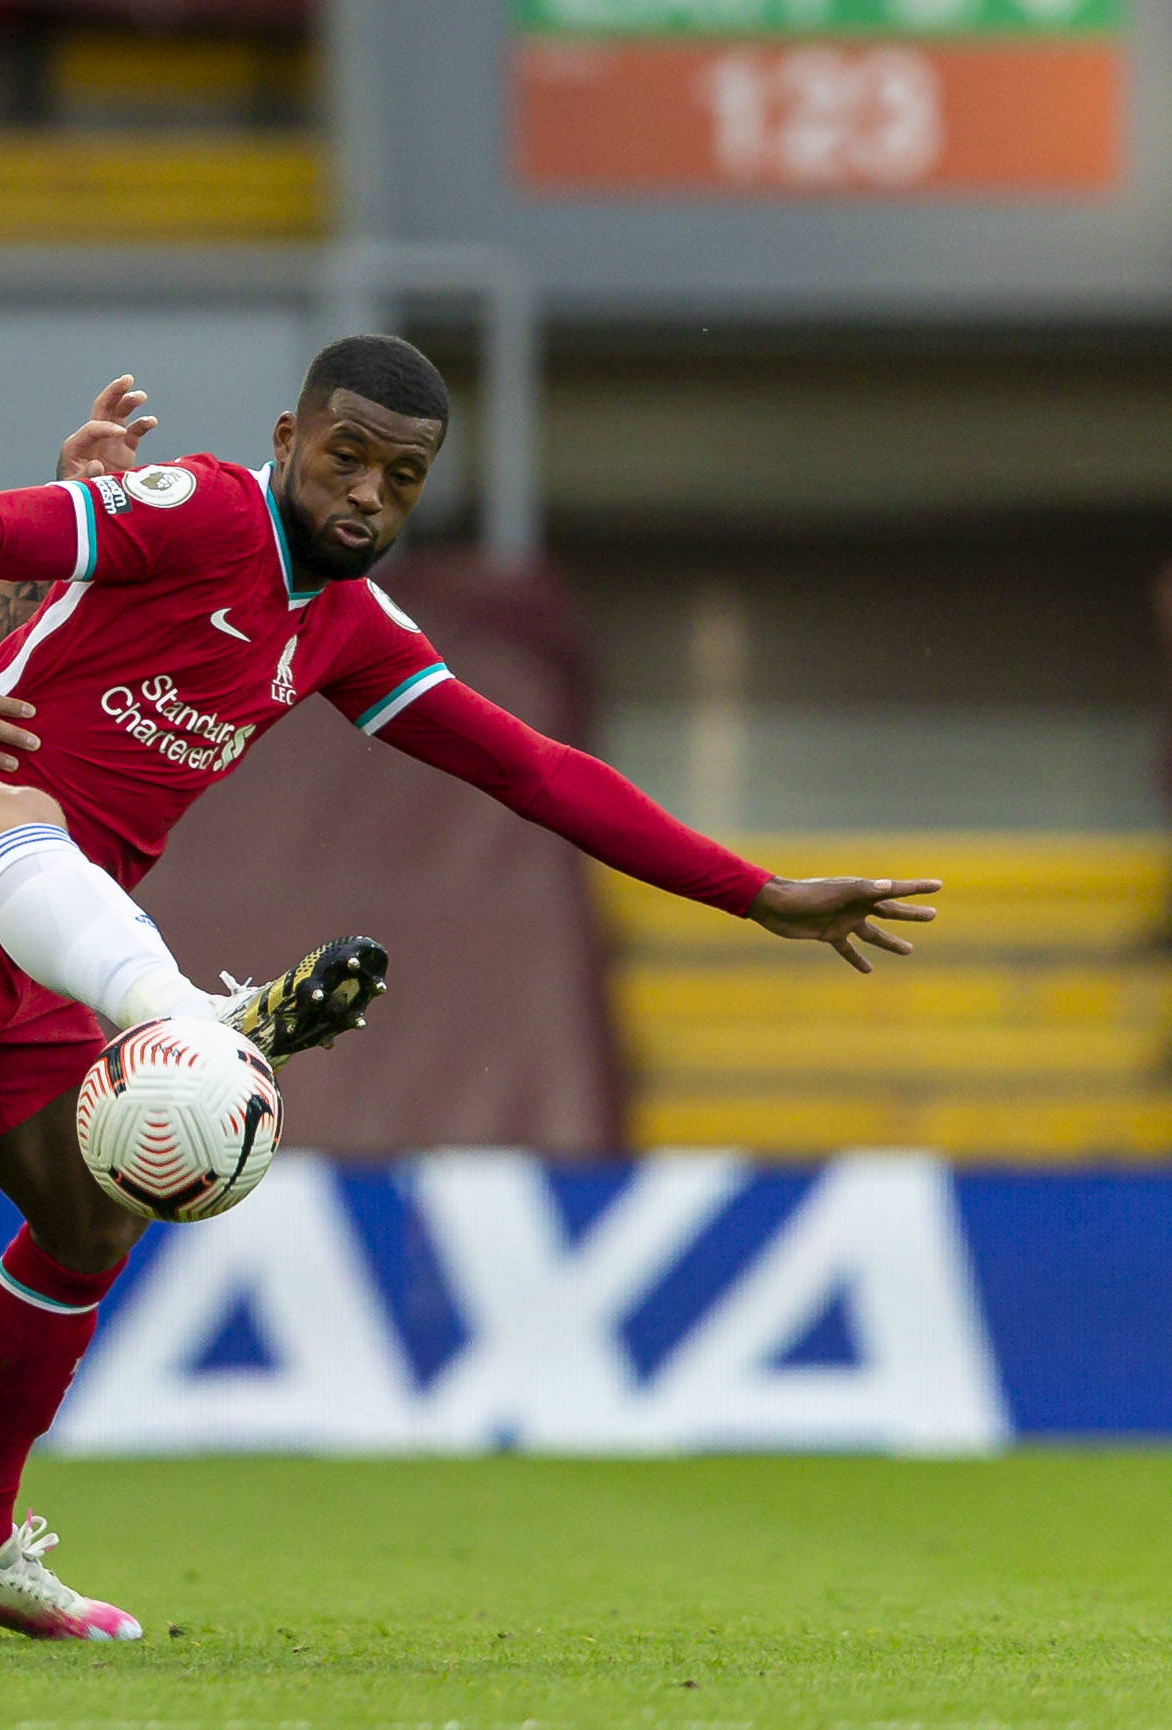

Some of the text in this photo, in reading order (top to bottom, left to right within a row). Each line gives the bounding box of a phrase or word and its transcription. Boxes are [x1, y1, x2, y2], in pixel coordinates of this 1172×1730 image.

[704, 46, 940, 184] 123
[100, 686, 220, 770] Chartered
[141, 674, 236, 744] Standar
[270, 683, 297, 705] LFC
[50, 1150, 1024, 1458] AXA
